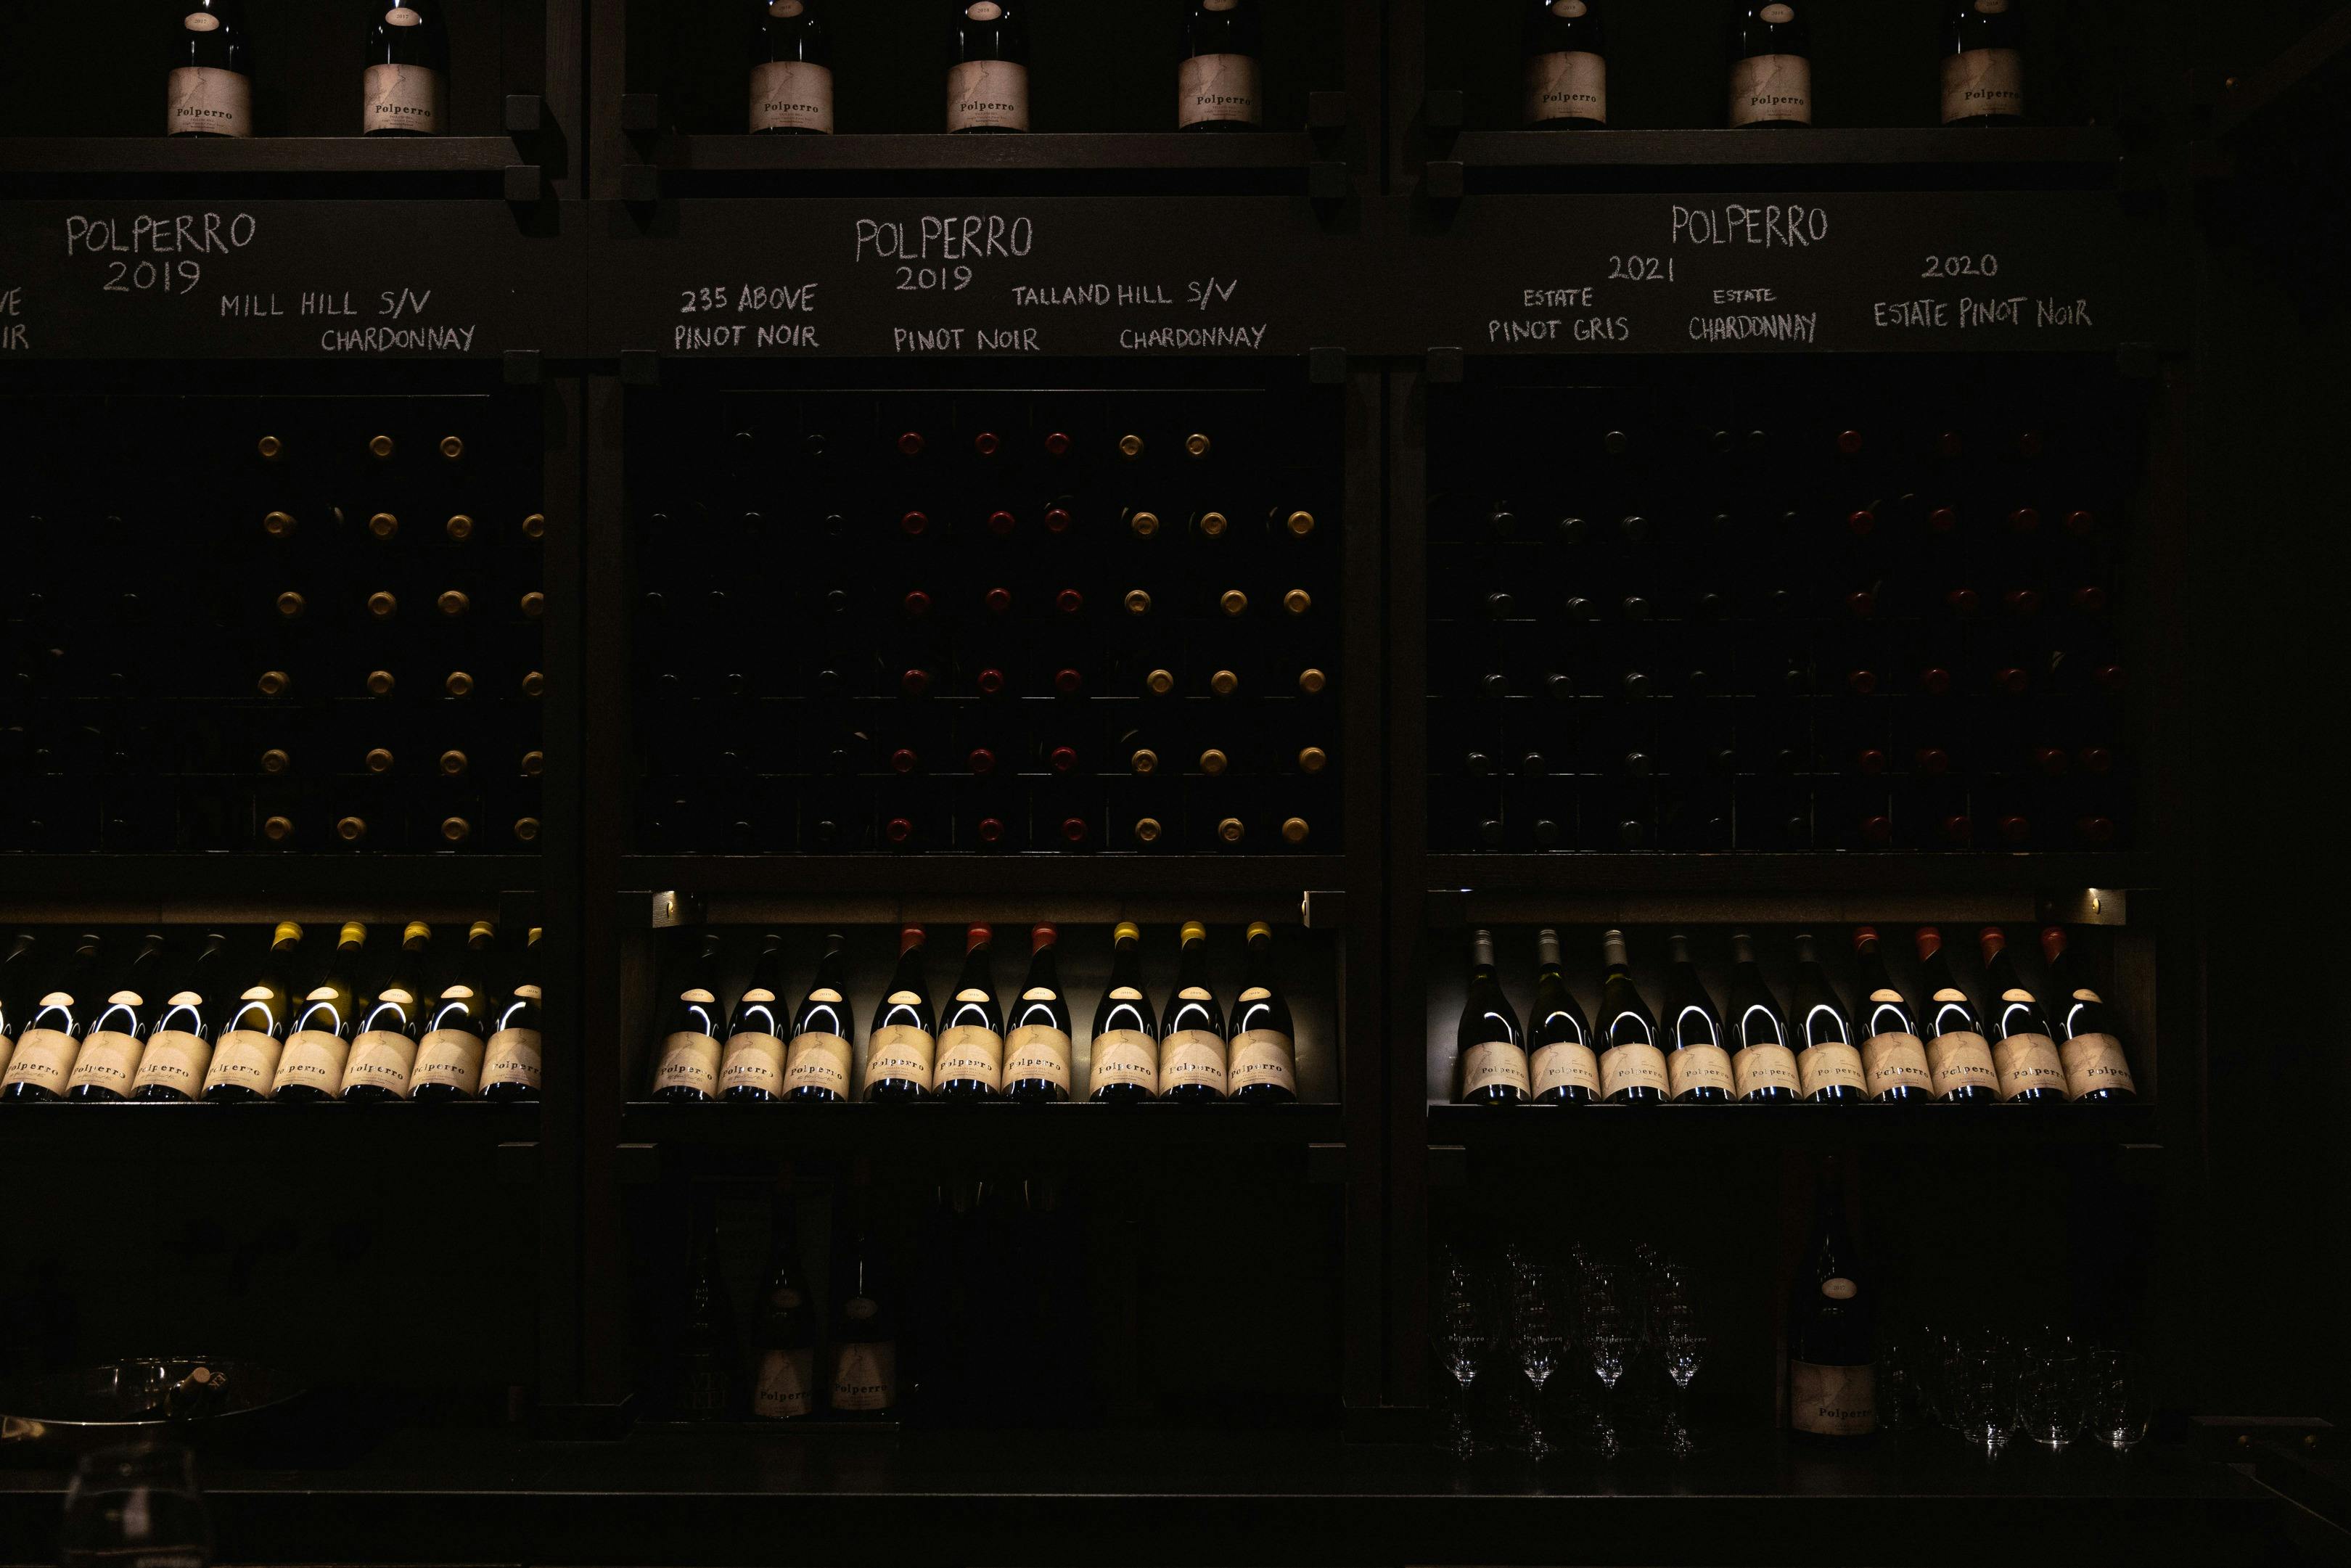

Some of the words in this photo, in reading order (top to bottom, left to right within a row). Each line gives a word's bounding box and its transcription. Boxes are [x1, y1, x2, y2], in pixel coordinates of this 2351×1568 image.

[1197, 94, 1252, 105] Polperro
[1543, 92, 1596, 103] Polperro
[1751, 95, 1805, 106] Polperro
[1964, 89, 2020, 100] Polperro
[176, 106, 232, 120] Polperro
[375, 103, 431, 117] Polperro
[764, 101, 818, 112] Polperro
[961, 100, 1014, 112] Polperro
[66, 212, 256, 255] POLPERRO
[1672, 203, 1829, 247] POLPERRO
[856, 215, 1033, 263] POLPERRO
[1607, 255, 1674, 282] 2021
[1920, 253, 1998, 279] 2020
[103, 260, 200, 295] 2019
[895, 265, 973, 291] 2019
[680, 287, 728, 314] 235
[737, 283, 819, 313] ABOVE
[1012, 283, 1110, 307] TALLAND
[1117, 284, 1173, 305] HILL
[1186, 276, 1238, 311] S/V
[1524, 286, 1593, 308] ESTATE
[1712, 288, 1778, 304] ESTATE
[221, 293, 284, 317] MILL
[301, 291, 358, 316] HILL
[378, 287, 432, 320] S/V
[1874, 299, 1949, 328] ESTATE
[1959, 296, 2029, 329] PINOT
[674, 324, 747, 350] PINOT
[758, 324, 821, 348] NOIR
[1120, 323, 1268, 351] CHARDONNAY
[1488, 318, 1562, 343] PINOT
[1573, 316, 1630, 342] GRIS
[1689, 312, 1818, 344] CHARDONNAY
[321, 324, 476, 353] CHARDONNAY
[894, 327, 965, 353] PINOT
[977, 327, 1041, 352] NOIR
[275, 1064, 326, 1077] Poperro
[493, 1060, 541, 1074] Polperr
[790, 1064, 842, 1080] Polperro
[871, 1058, 924, 1072] Polperro
[940, 1058, 993, 1071] Polperro
[1482, 1066, 1525, 1079] Polperro
[1875, 1066, 1929, 1079] Polperro
[2013, 1067, 2065, 1080] Poperro
[835, 1383, 887, 1395] Polperro
